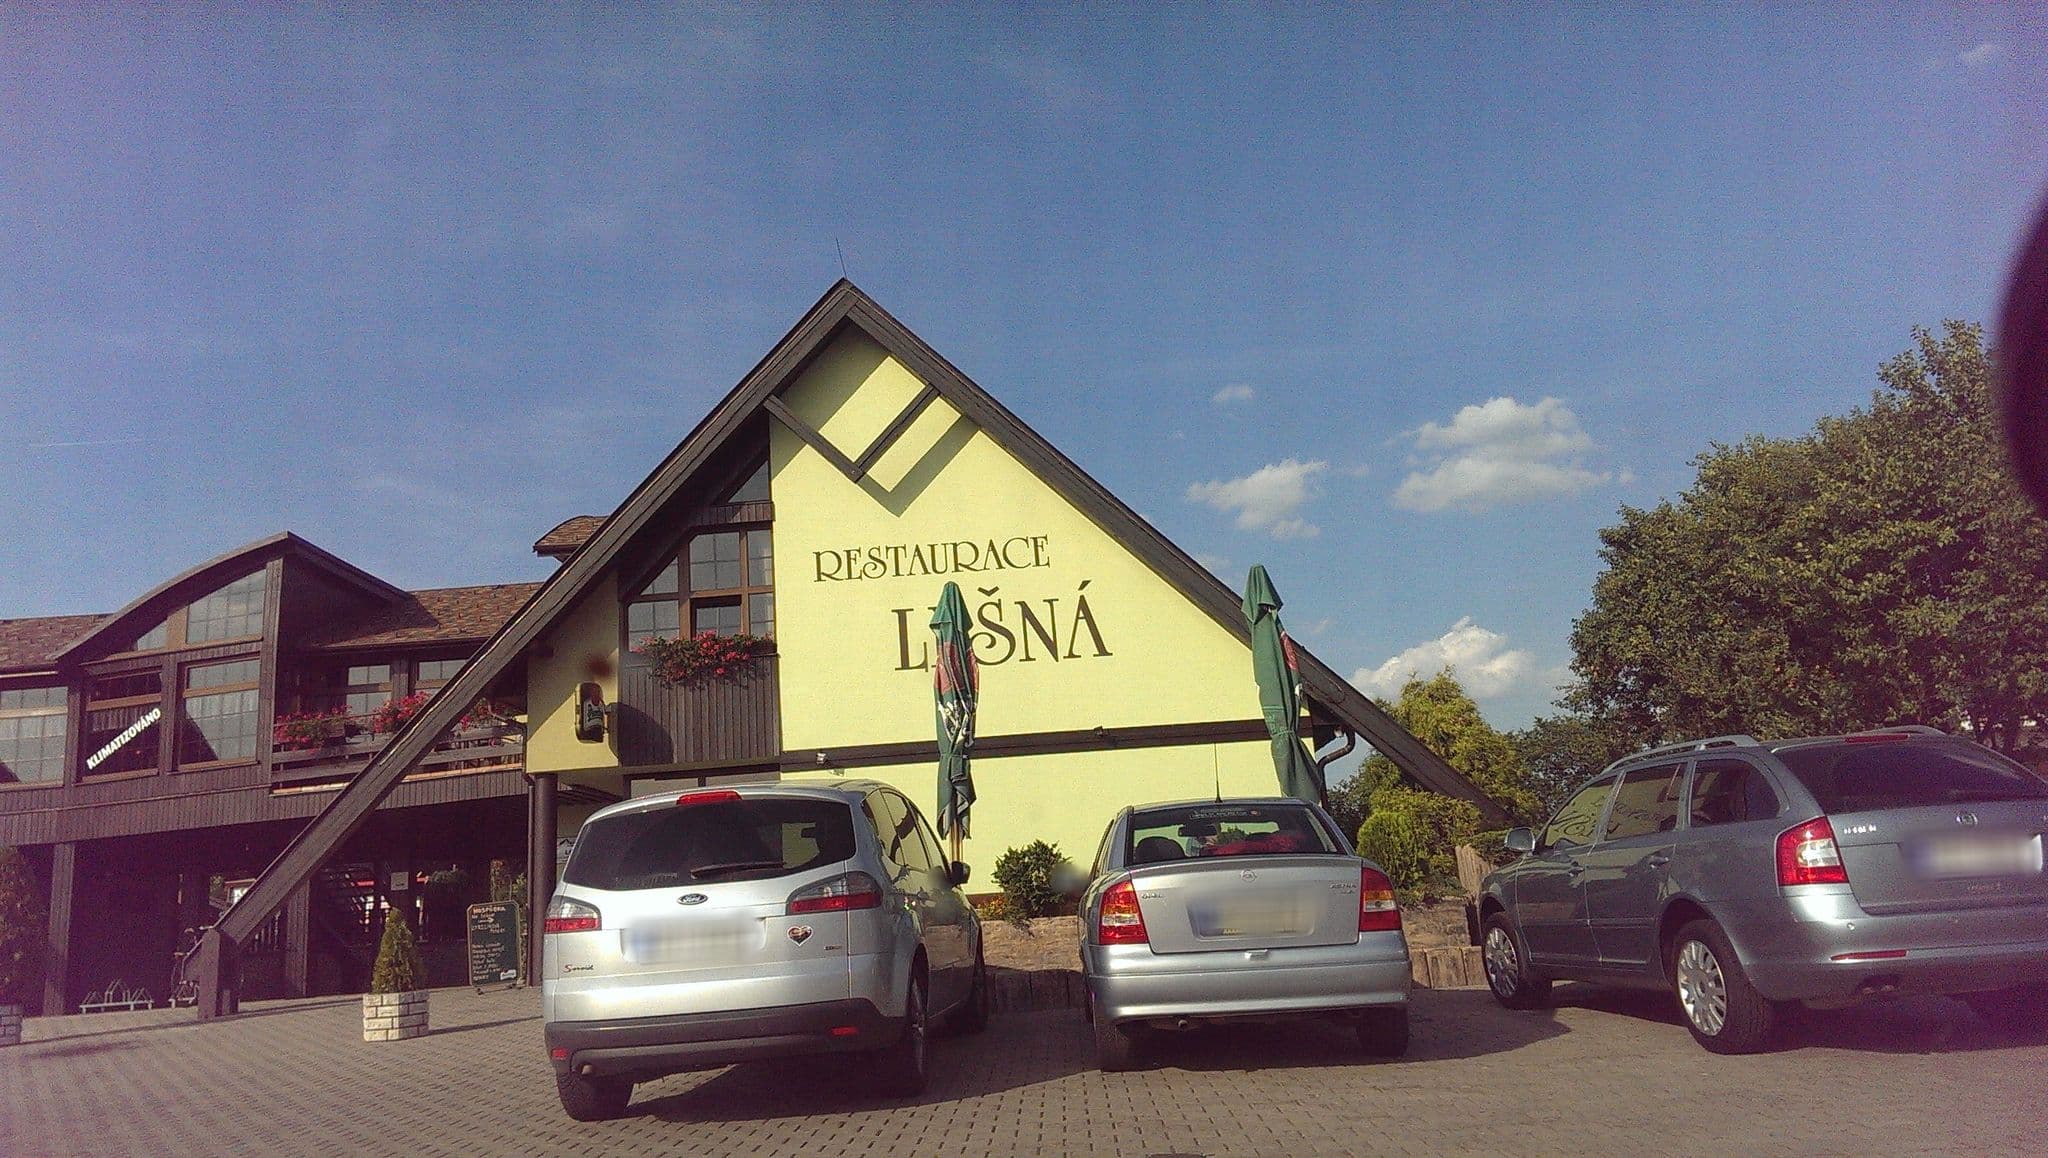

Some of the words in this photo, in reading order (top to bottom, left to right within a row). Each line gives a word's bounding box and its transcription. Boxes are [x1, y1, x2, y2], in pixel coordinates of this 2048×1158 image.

[813, 534, 1050, 583] RESTAURACE
[891, 580, 1113, 673] LŠNÁ
[86, 707, 161, 770] KLIMATIZOVÁNO
